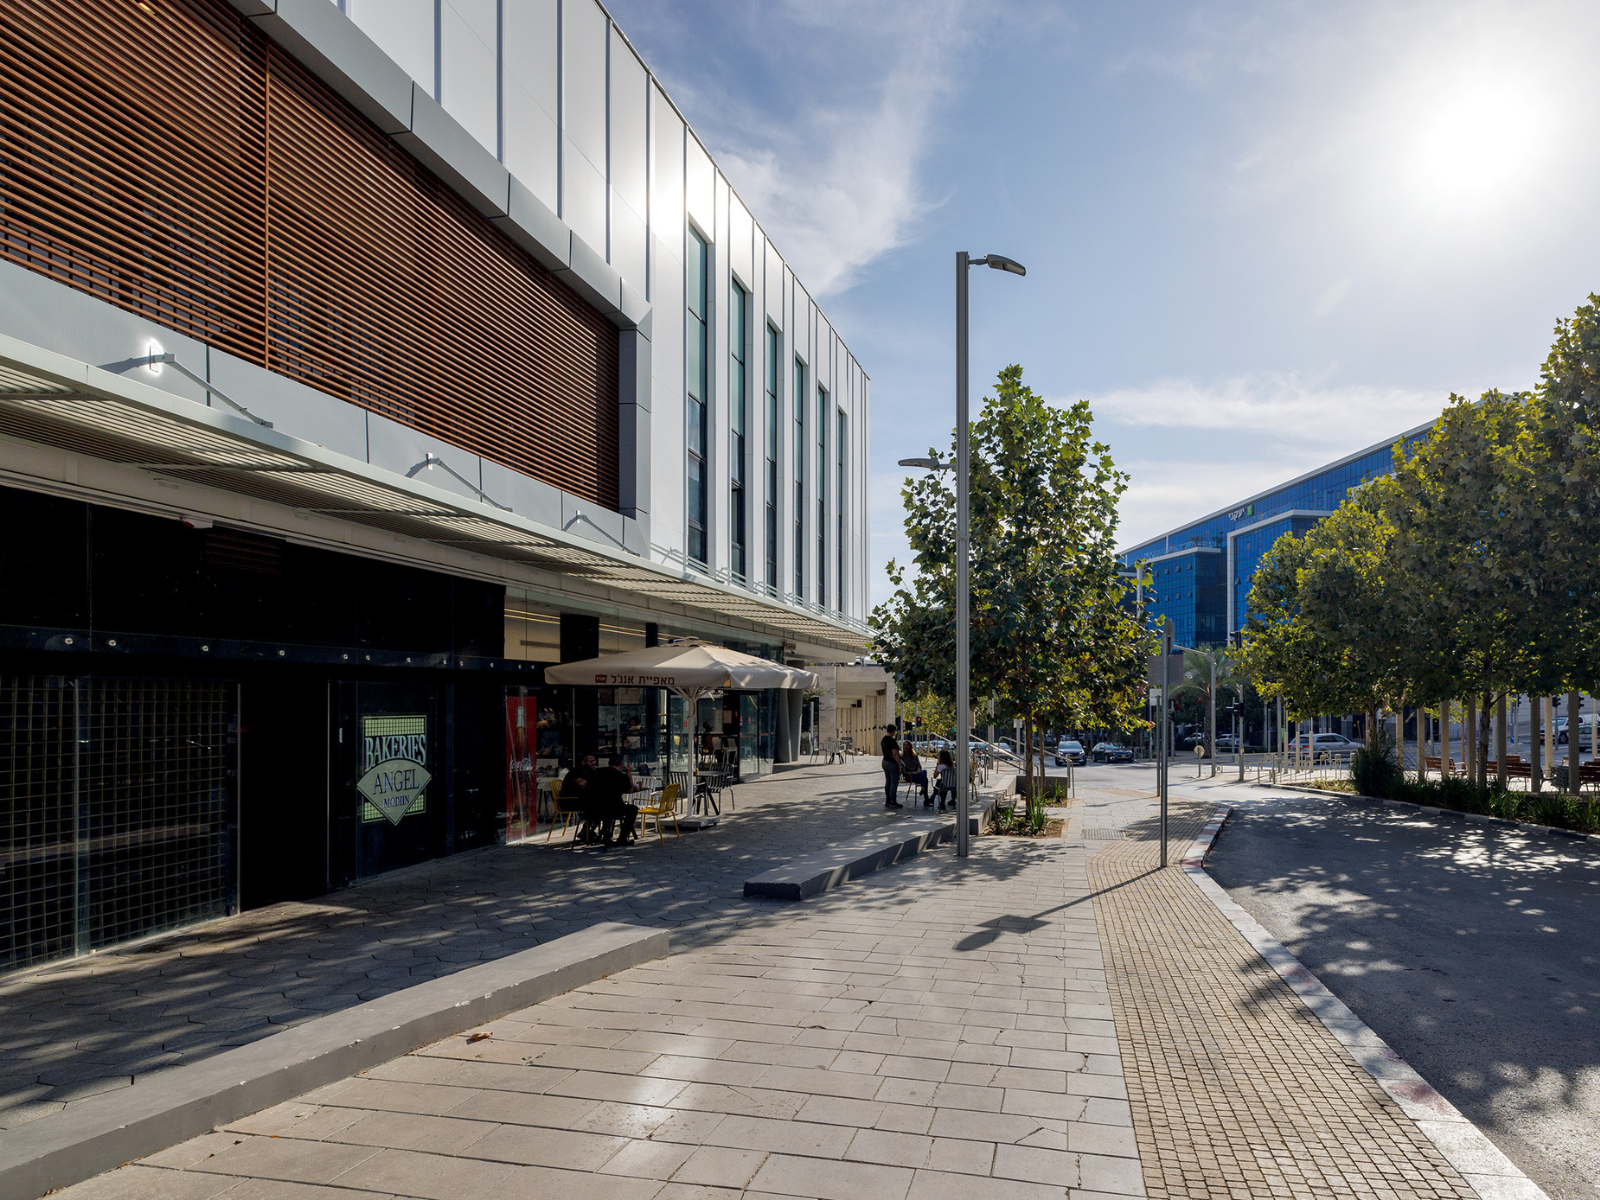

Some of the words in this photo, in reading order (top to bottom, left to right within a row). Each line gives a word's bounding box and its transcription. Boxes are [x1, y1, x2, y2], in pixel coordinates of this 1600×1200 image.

[638, 675, 675, 685] מאפיית
[365, 734, 426, 771] BAKERIES
[372, 768, 420, 795] ANGEL
[382, 795, 410, 808] MODIIN
